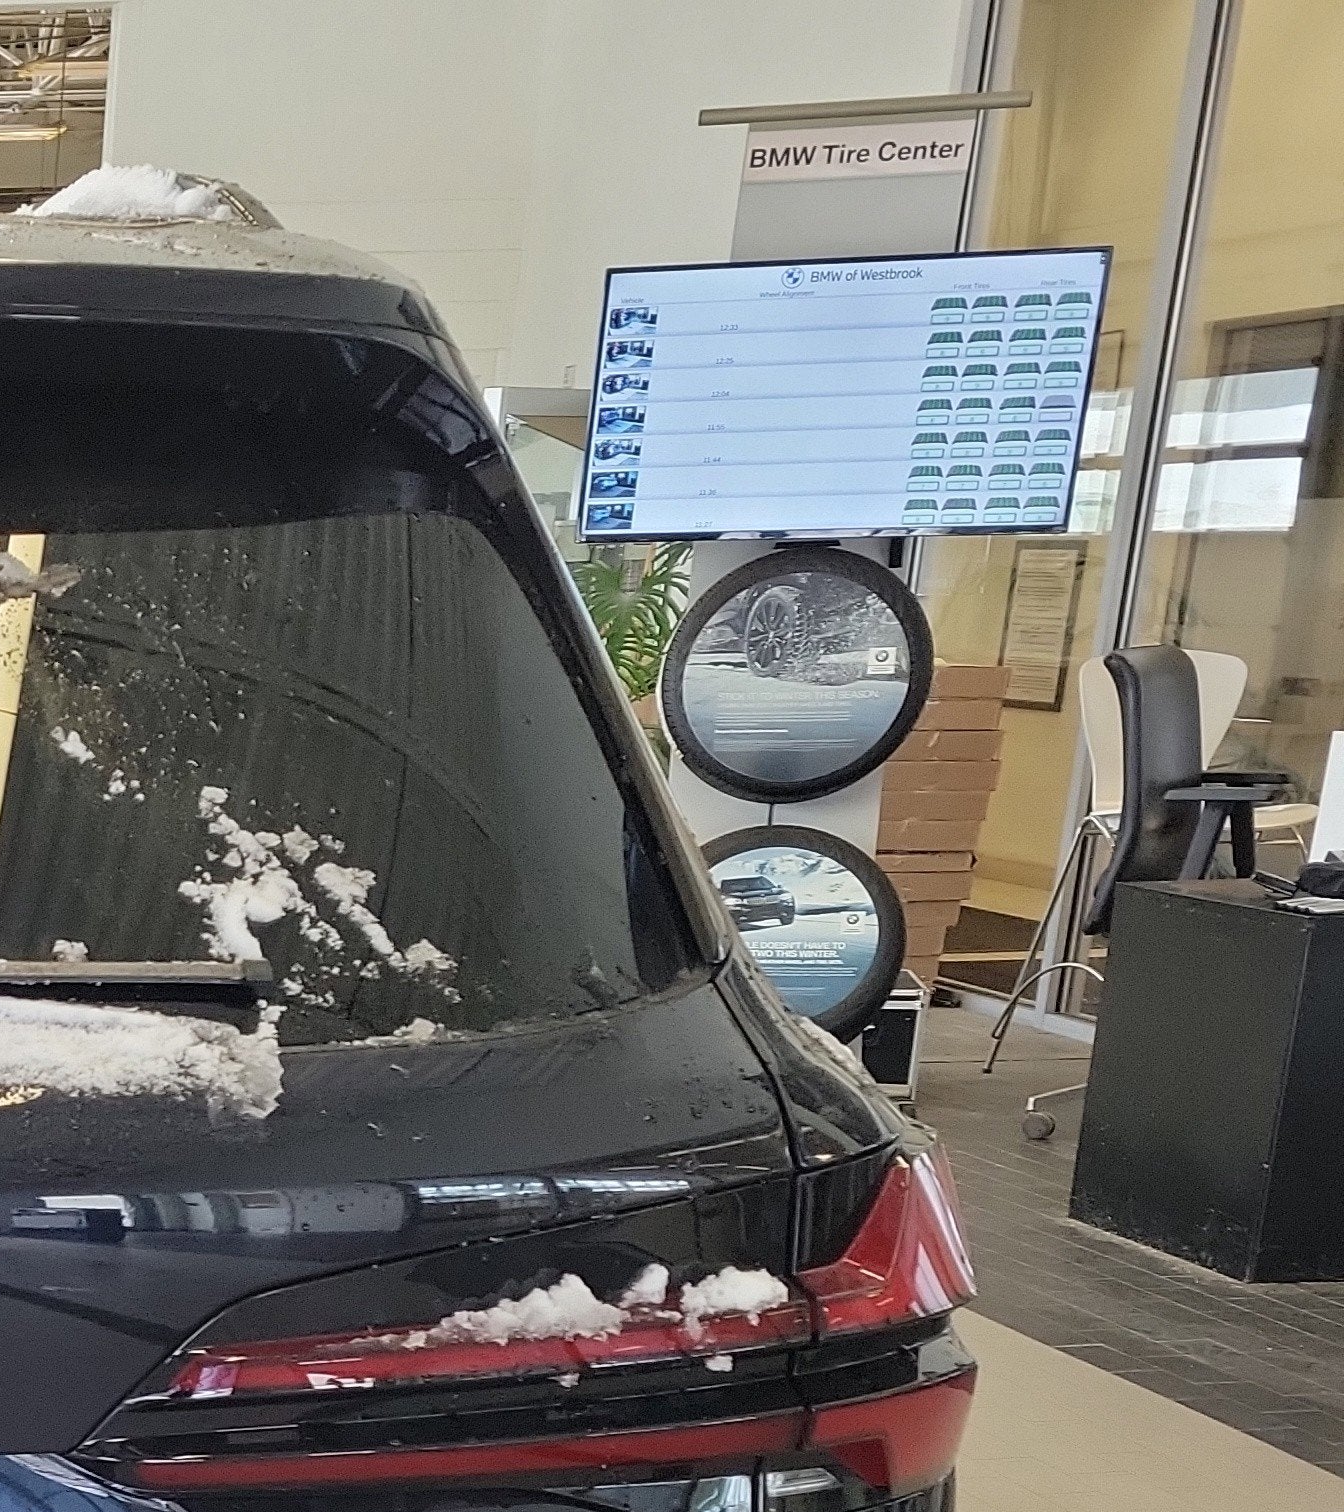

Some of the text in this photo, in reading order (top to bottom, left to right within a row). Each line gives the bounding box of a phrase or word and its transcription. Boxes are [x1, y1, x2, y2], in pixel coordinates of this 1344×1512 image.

[749, 140, 965, 168] BMW Tire Center
[810, 267, 923, 283] BMW of Westbrook
[781, 290, 815, 299] Alignment
